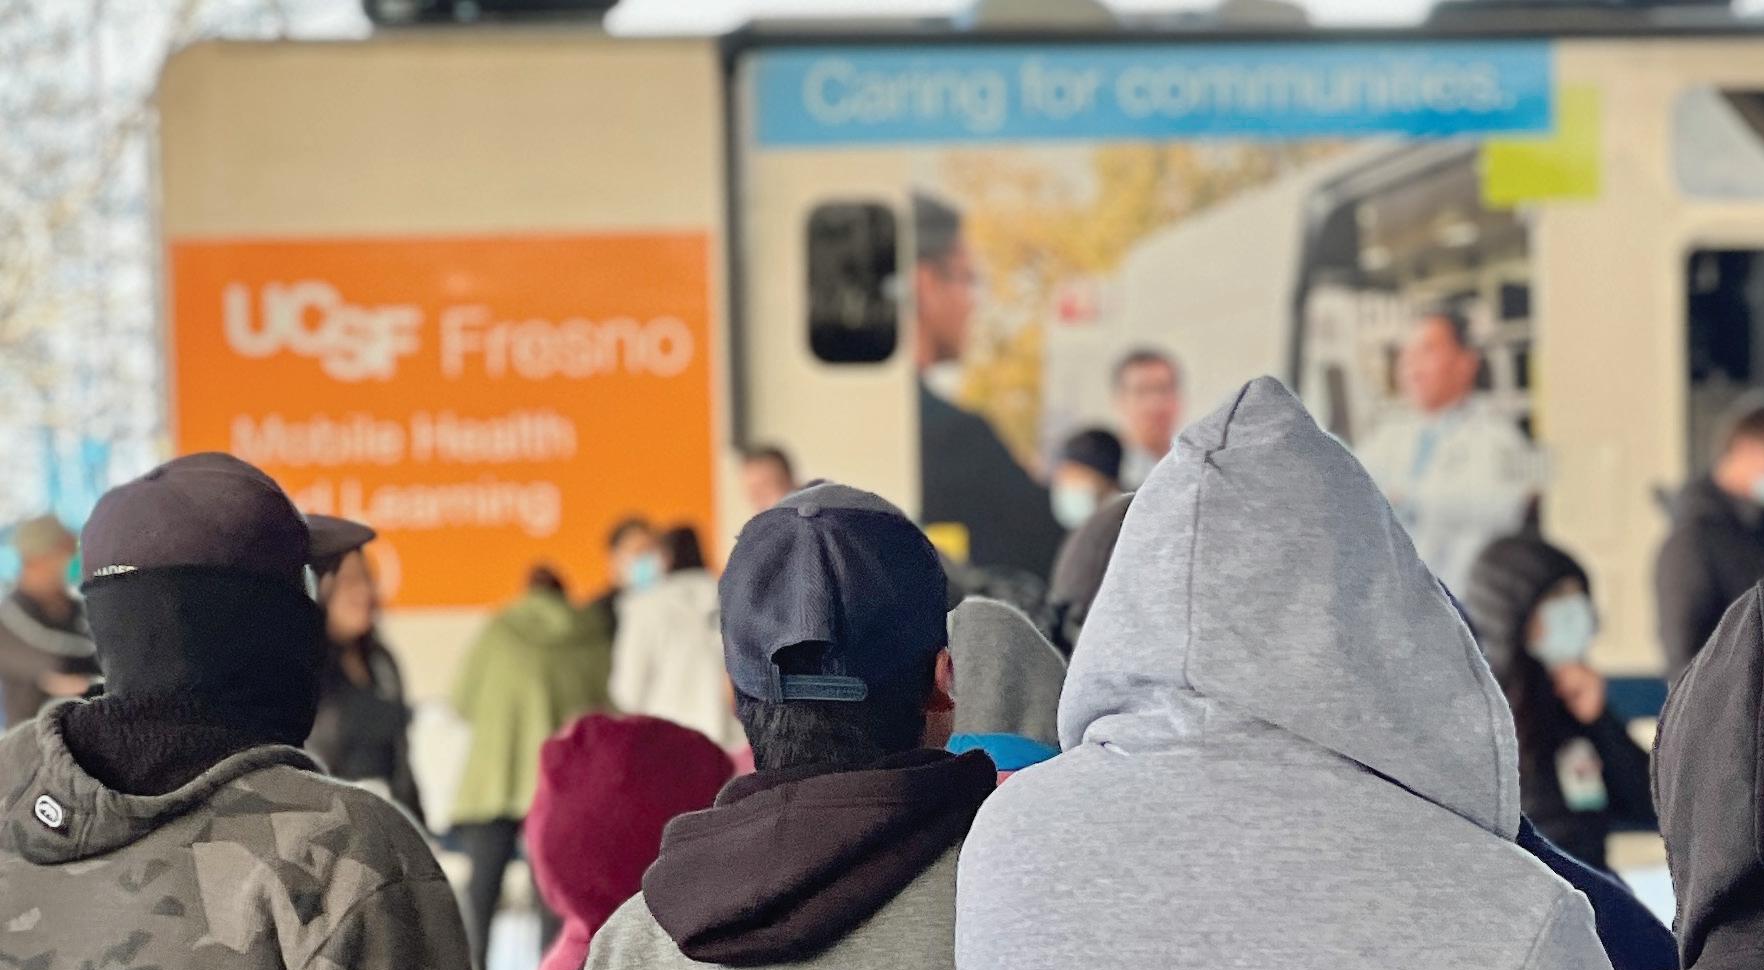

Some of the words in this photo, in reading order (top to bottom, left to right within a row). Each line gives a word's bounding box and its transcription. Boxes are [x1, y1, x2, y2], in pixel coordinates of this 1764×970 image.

[803, 57, 1006, 131] Caring
[1021, 54, 1100, 119] for
[1116, 52, 1518, 119] communities.
[223, 280, 423, 381] UCSF
[439, 304, 694, 379] Fresno
[231, 413, 404, 465] Mobile
[411, 407, 577, 463] Health
[340, 478, 562, 537] Learning
